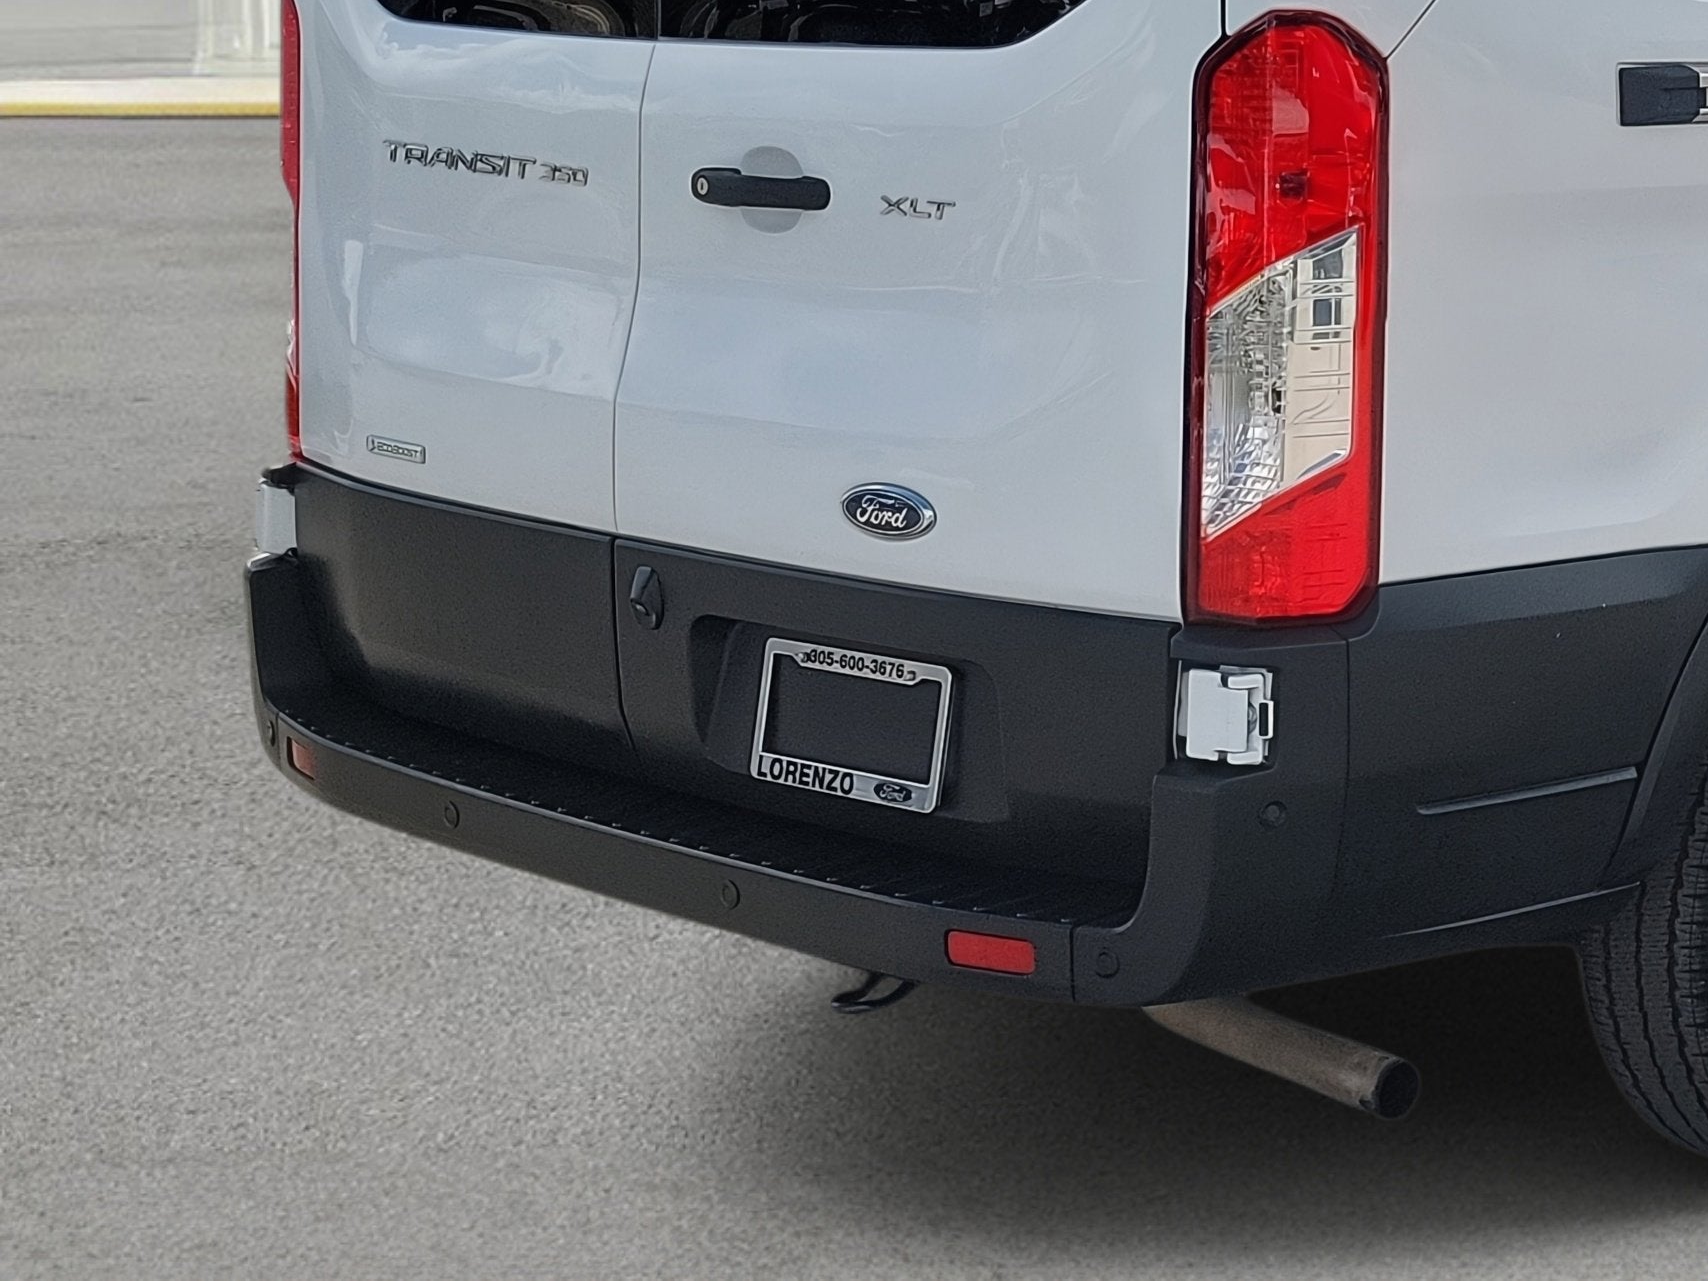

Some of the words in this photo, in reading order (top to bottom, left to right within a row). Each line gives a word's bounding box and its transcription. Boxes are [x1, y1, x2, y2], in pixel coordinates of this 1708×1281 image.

[383, 139, 537, 180] TRANSIT
[539, 162, 589, 187] 350
[880, 195, 956, 220] XLT
[856, 495, 908, 528] Ford
[807, 649, 905, 679] 305-600-3676
[756, 754, 854, 796] LORENZO
